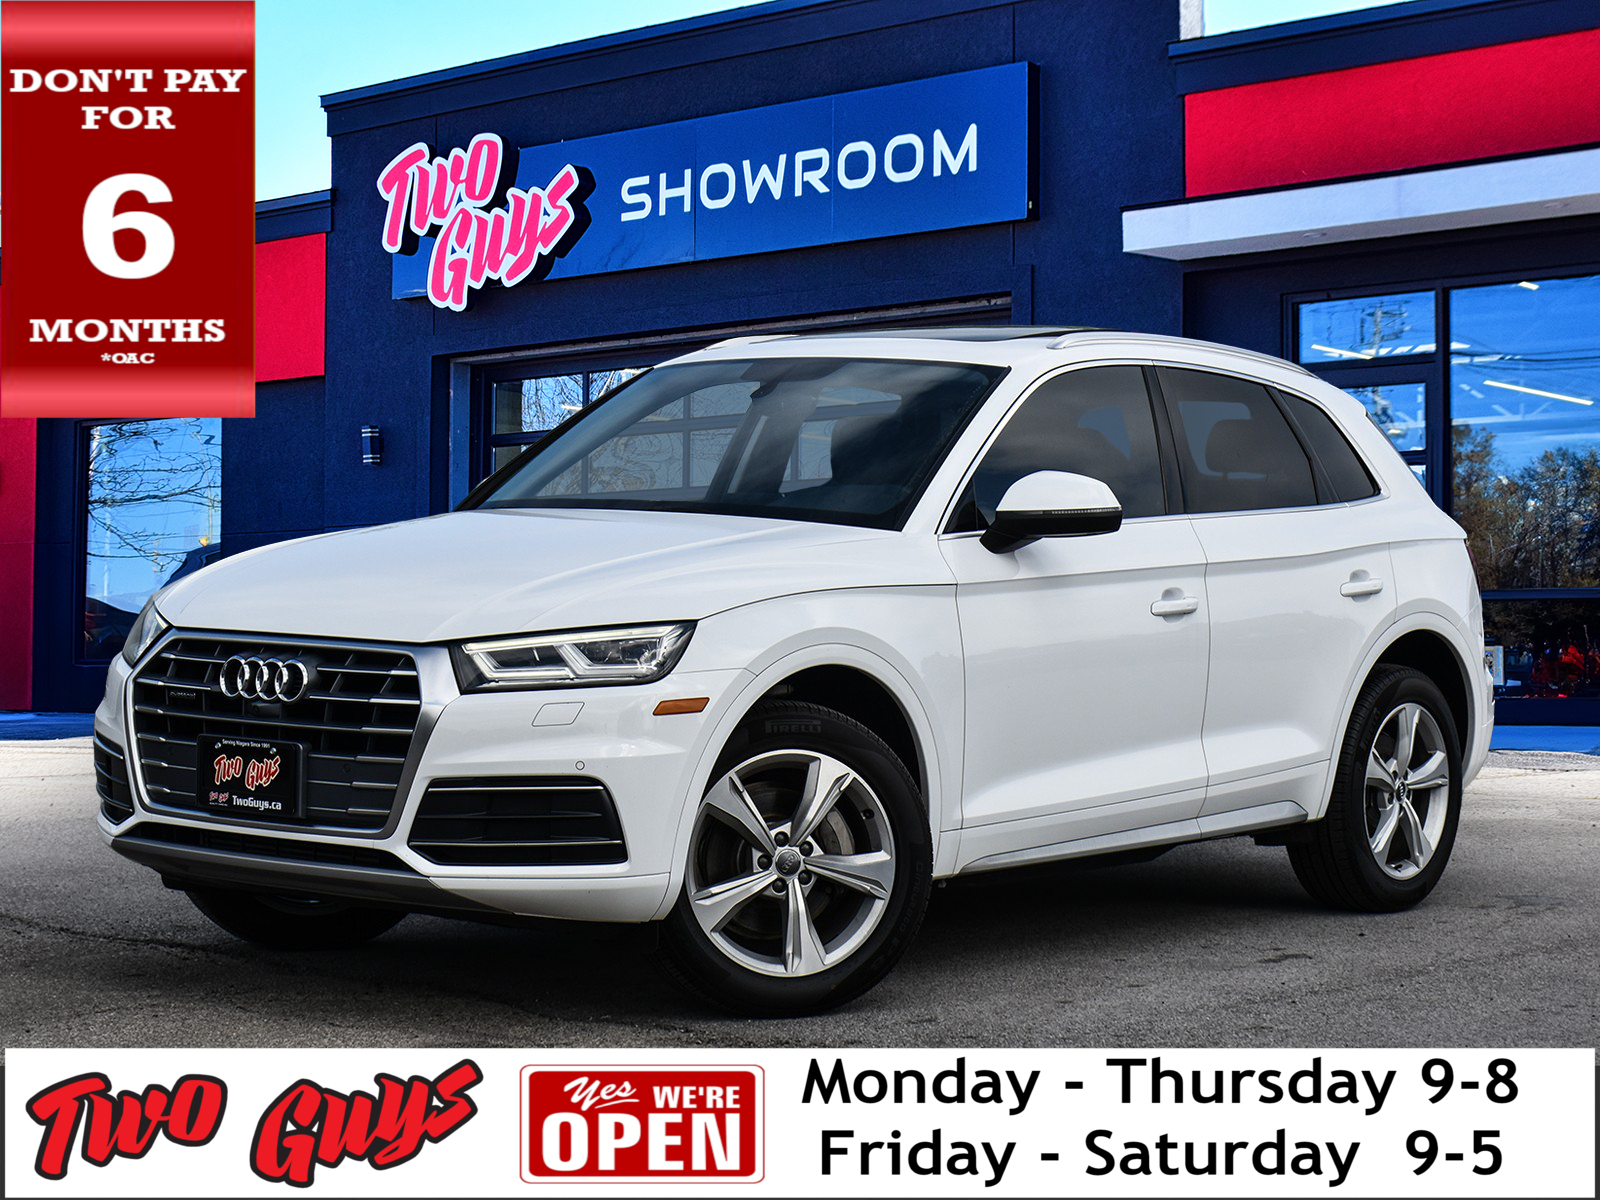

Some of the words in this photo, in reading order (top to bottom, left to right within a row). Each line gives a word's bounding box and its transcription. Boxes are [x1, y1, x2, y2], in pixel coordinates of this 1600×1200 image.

[621, 123, 977, 222] SHOWROOM
[765, 718, 822, 734] PIRELLI
[232, 795, 282, 811] TwoGuys.ca
